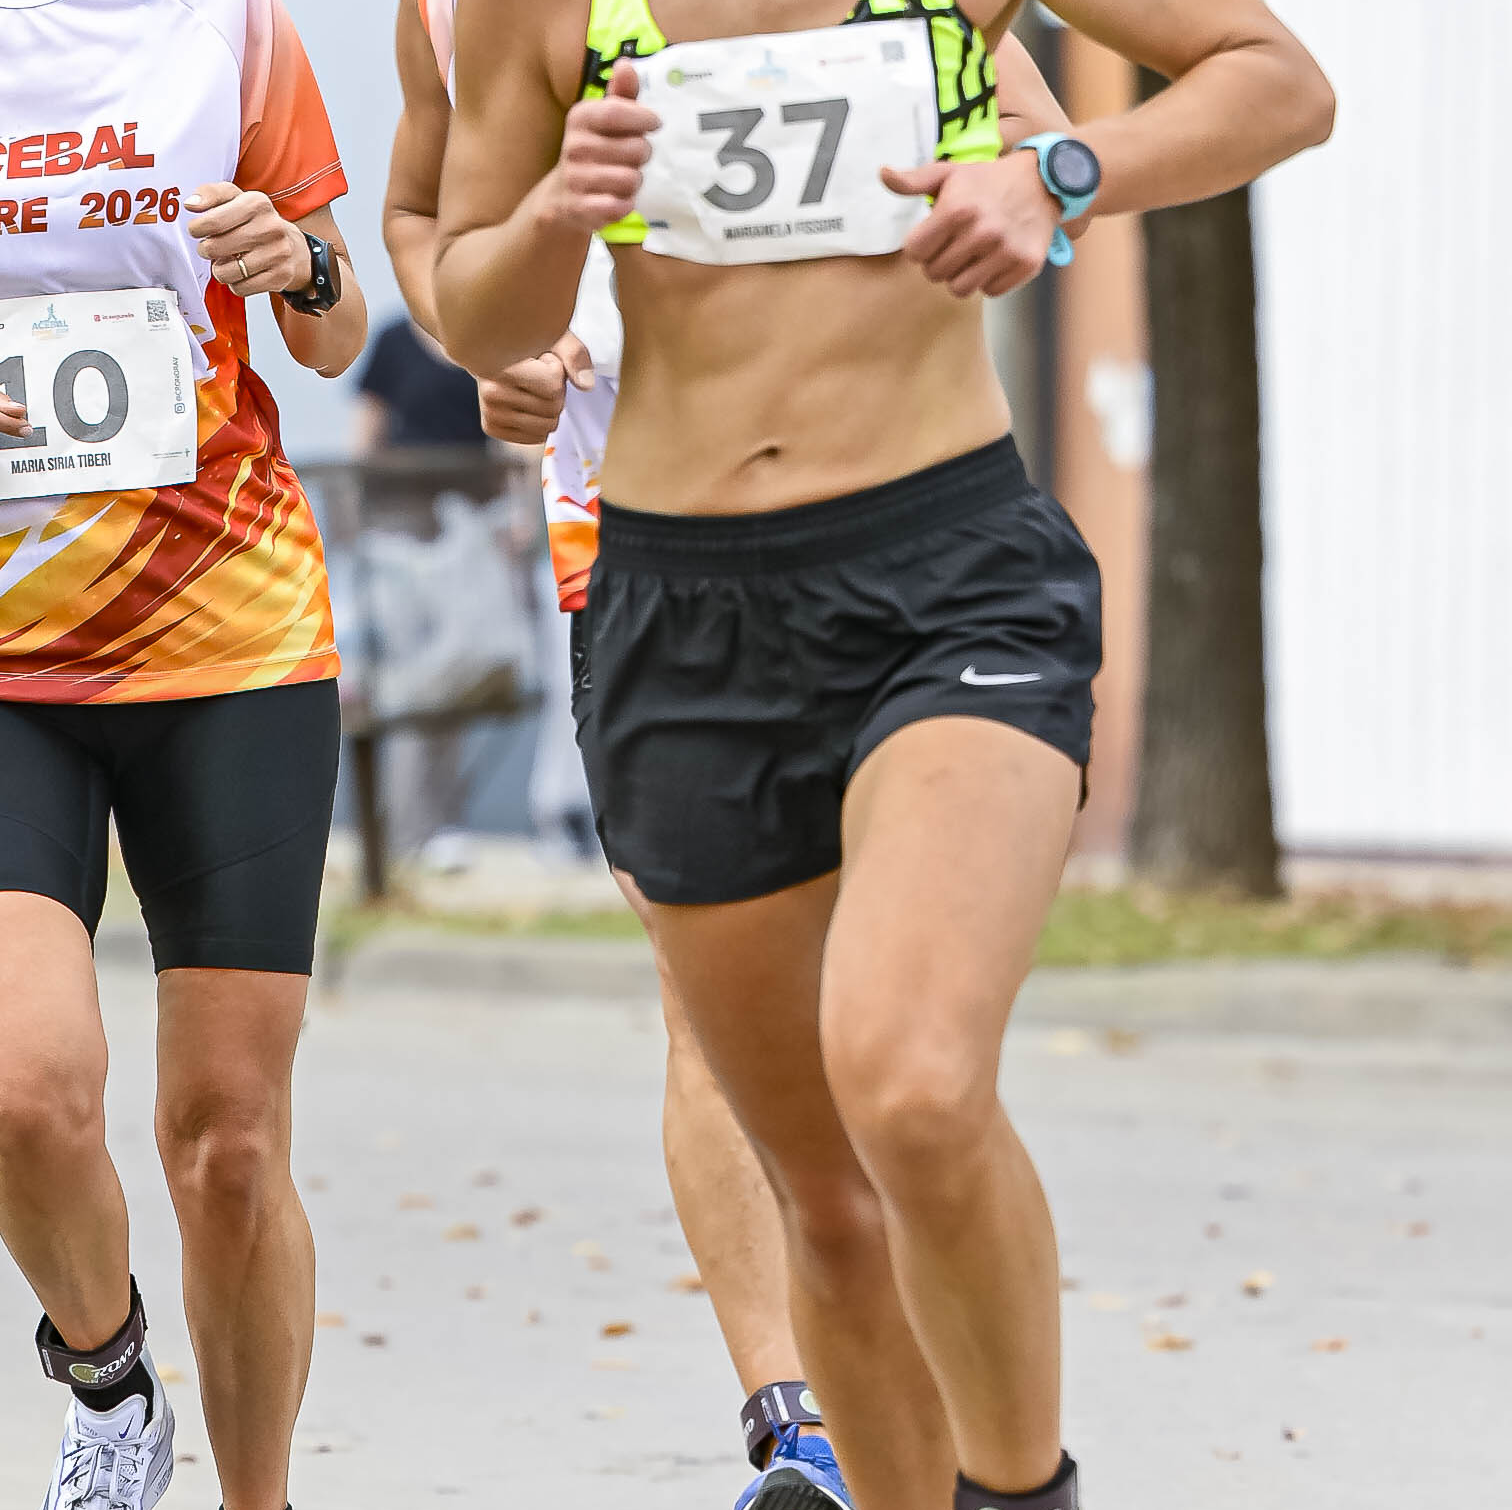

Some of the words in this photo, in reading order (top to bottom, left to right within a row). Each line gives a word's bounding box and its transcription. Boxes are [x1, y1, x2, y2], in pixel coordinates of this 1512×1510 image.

[697, 98, 849, 212] 37
[78, 187, 180, 230] 2026
[11, 459, 46, 474] MARIA
[48, 456, 75, 471] SIRIA
[77, 452, 111, 468] TIBERI
